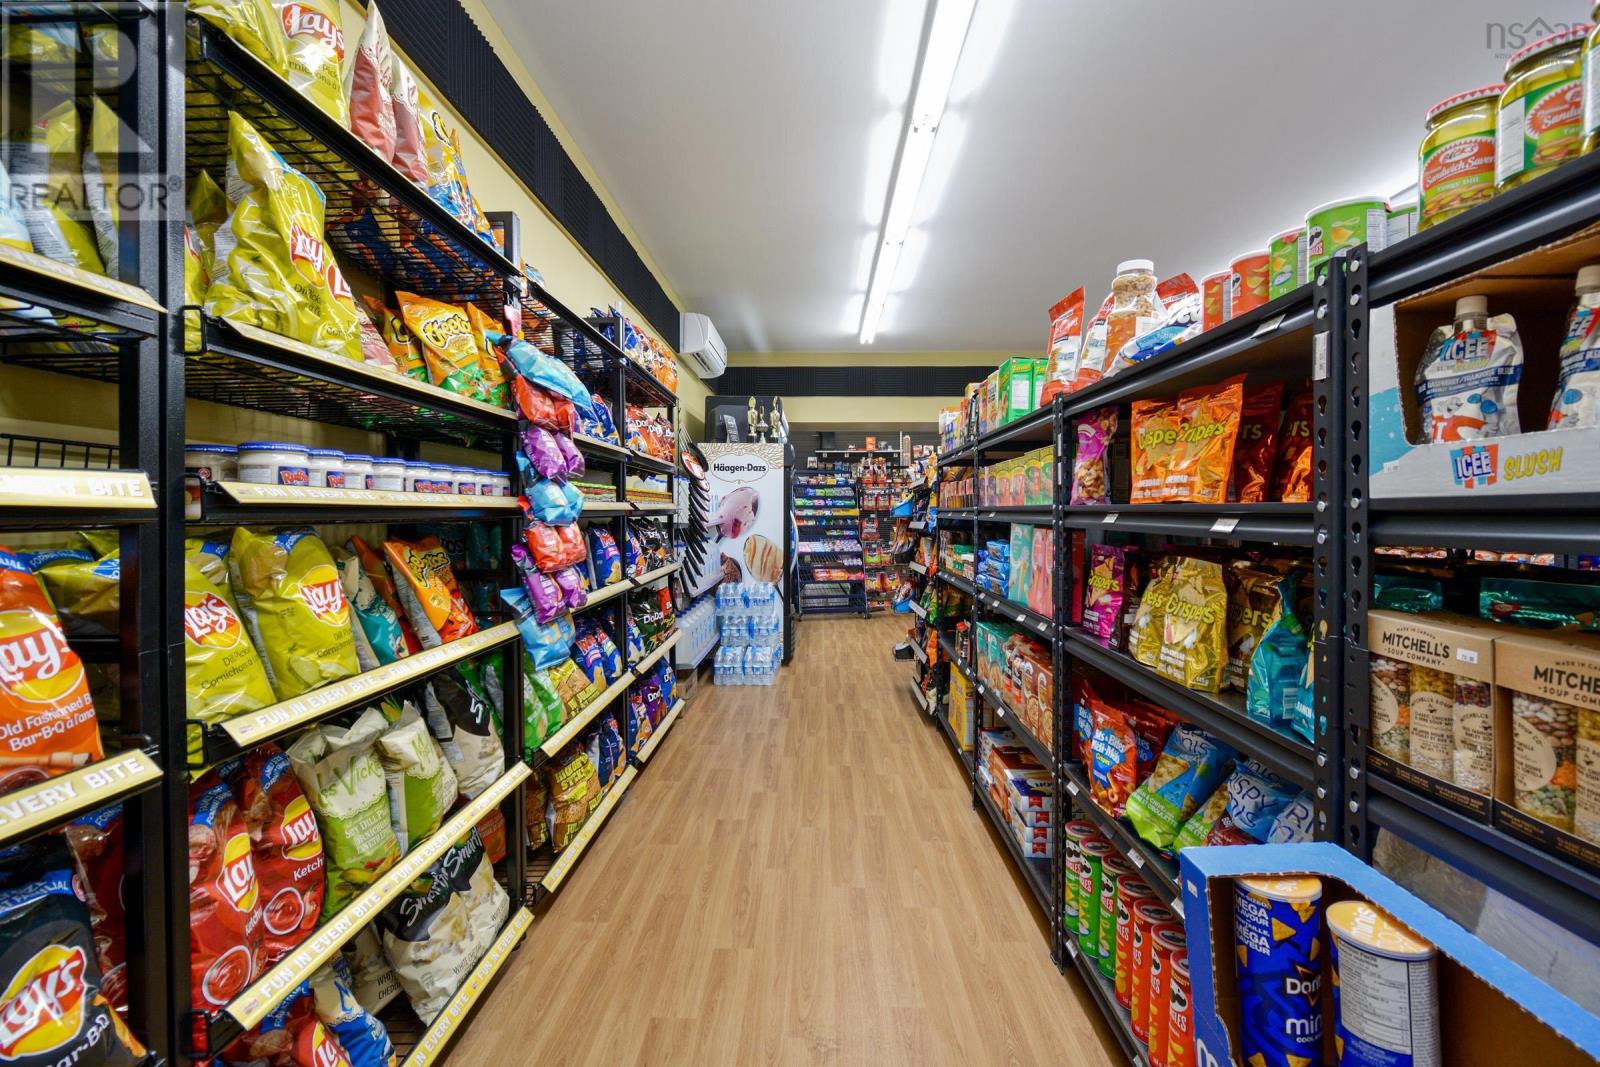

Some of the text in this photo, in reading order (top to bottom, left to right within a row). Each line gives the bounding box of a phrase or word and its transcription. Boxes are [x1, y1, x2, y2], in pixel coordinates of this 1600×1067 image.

[713, 463, 767, 474] Häagen-Dazs
[1455, 446, 1564, 482] ICEE SLUSH
[1165, 592, 1215, 625] Crispers
[1382, 631, 1450, 659] MITCHELL'S
[255, 674, 376, 730] FUN IN EVERY BITE
[82, 756, 146, 790] BITE
[391, 864, 414, 884] FUN
[424, 837, 450, 857] EVERY
[260, 892, 382, 999] FUN IN EVERY BITE
[413, 992, 470, 1067] IN EVERY BITE
